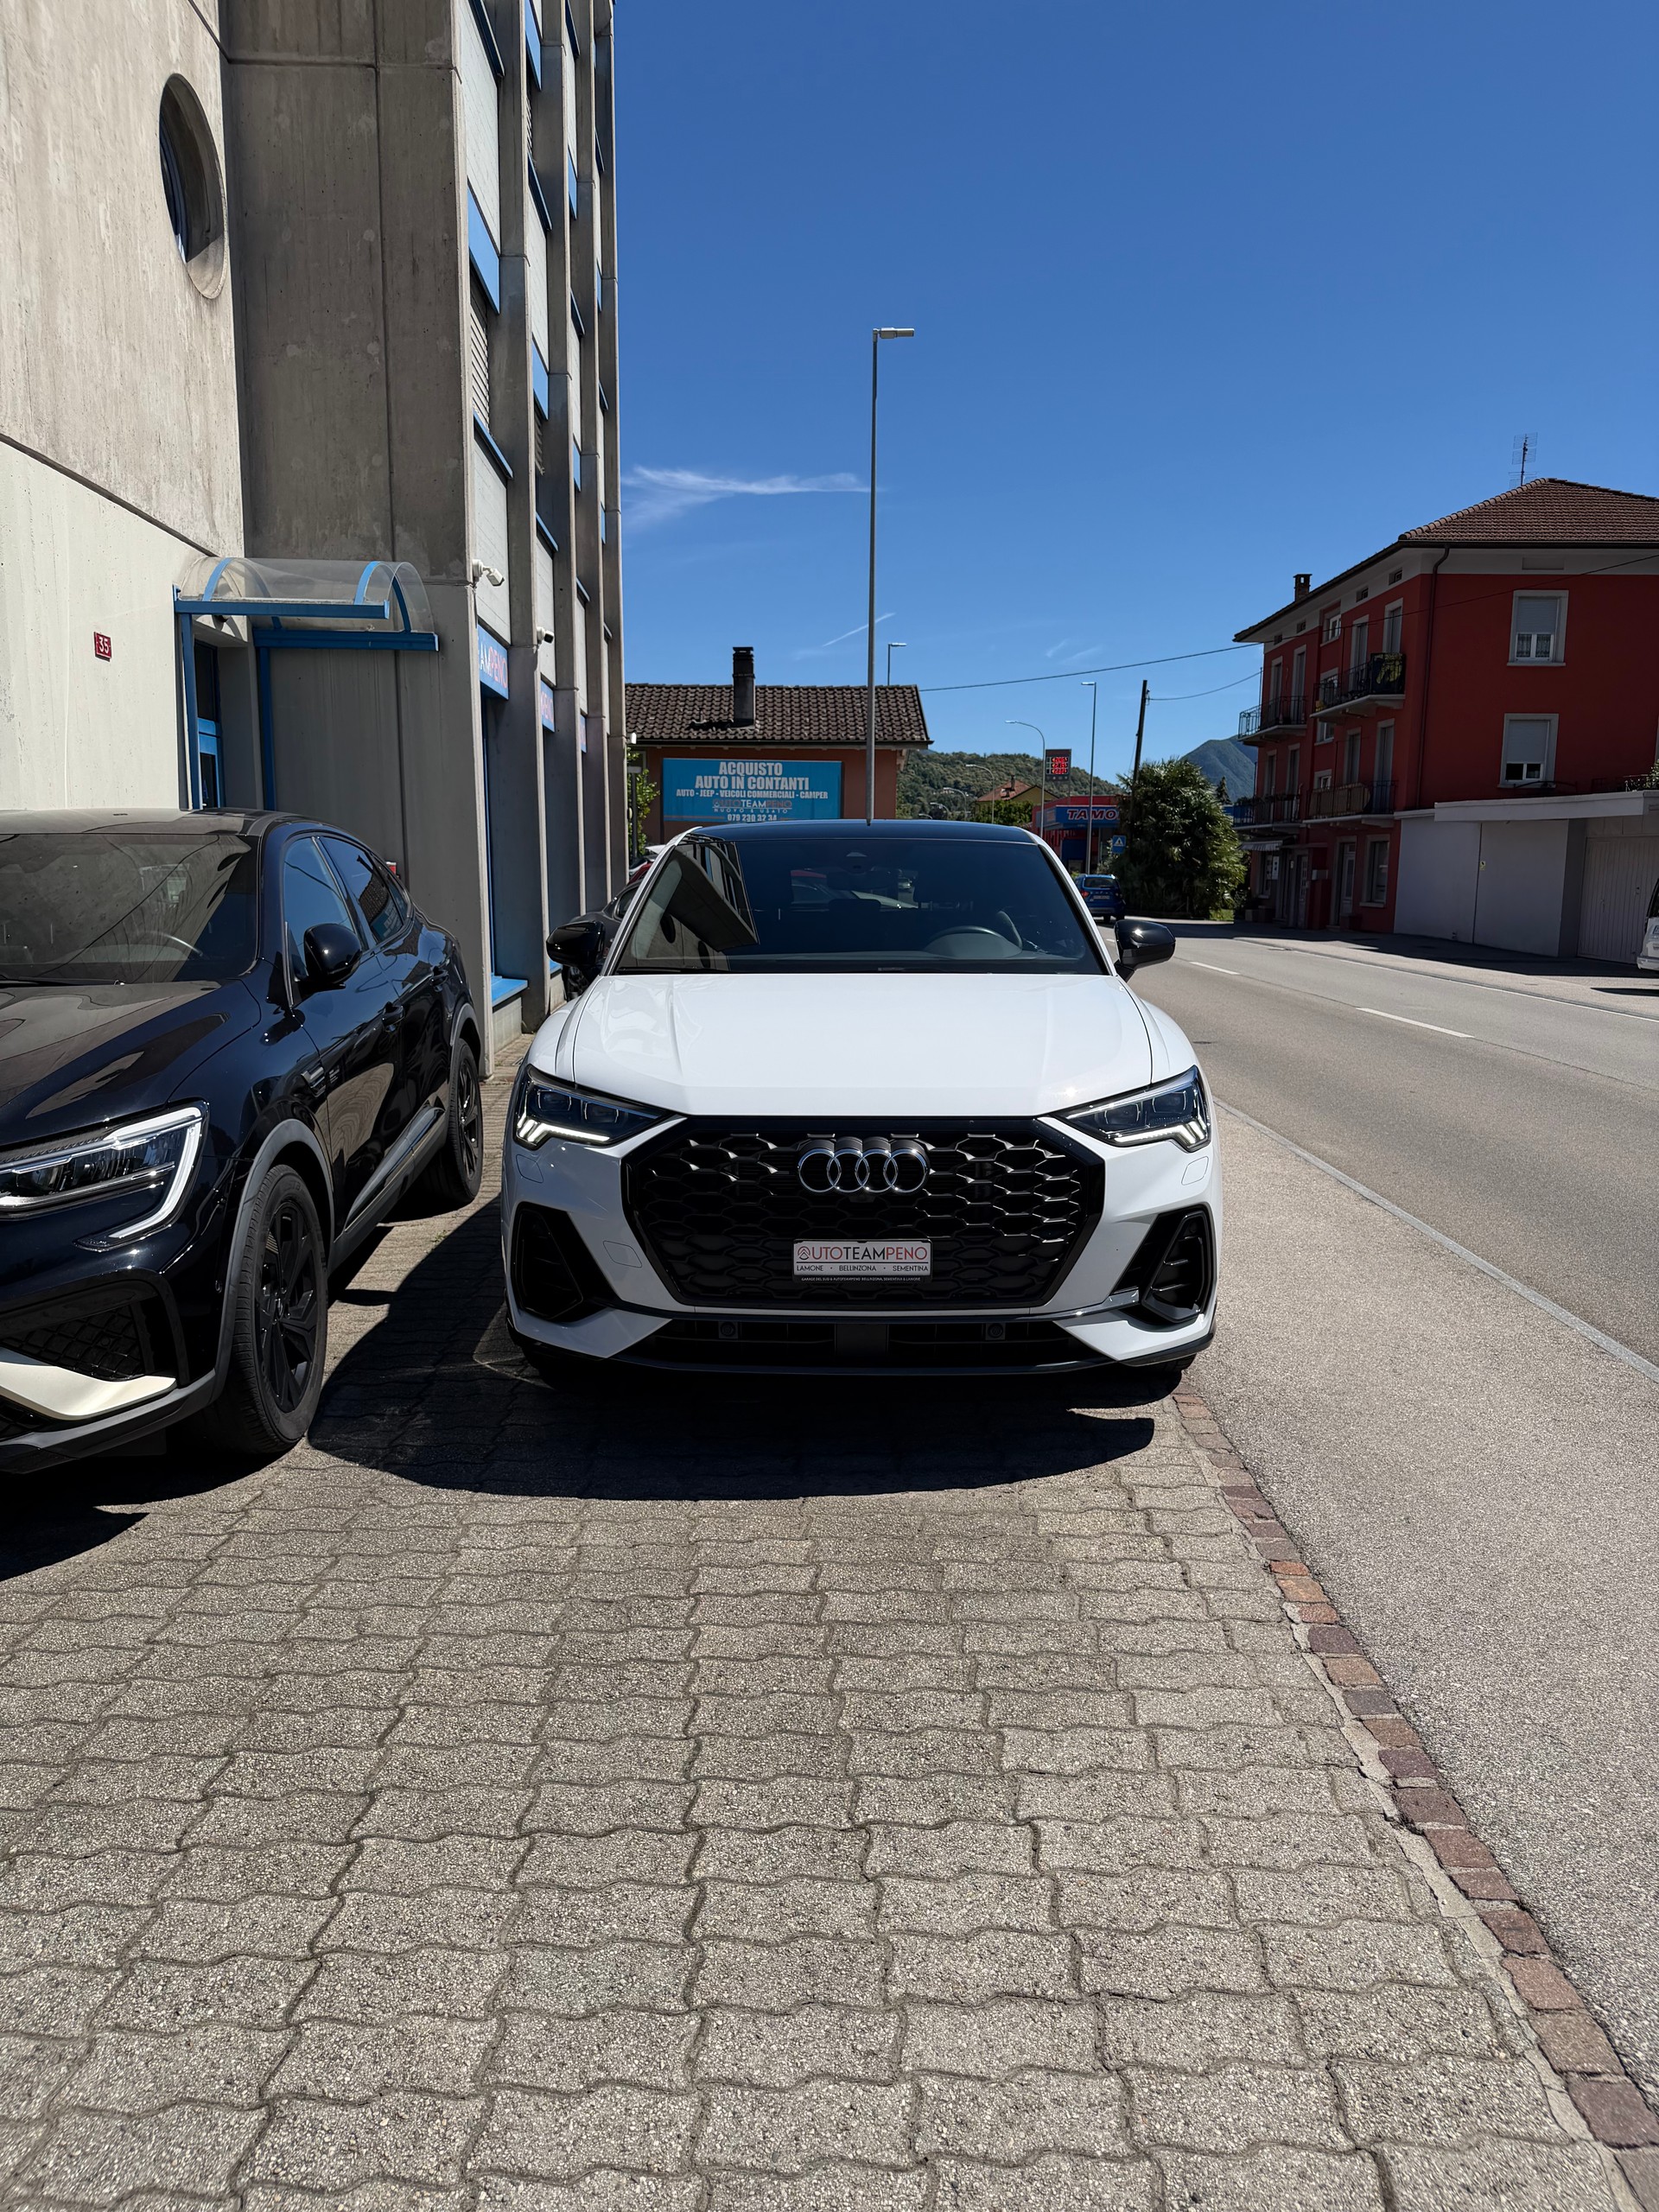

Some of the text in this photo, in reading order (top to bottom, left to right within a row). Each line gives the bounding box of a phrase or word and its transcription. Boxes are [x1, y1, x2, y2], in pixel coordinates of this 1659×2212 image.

[99, 636, 110, 654] 35
[719, 761, 783, 776] ACQUISTO
[695, 775, 810, 791] AUTO IN CONTANTI
[747, 790, 795, 798] COMMERCIALI
[799, 791, 828, 799] CAMPER
[741, 814, 756, 823] 230
[1066, 809, 1121, 820] TAMO
